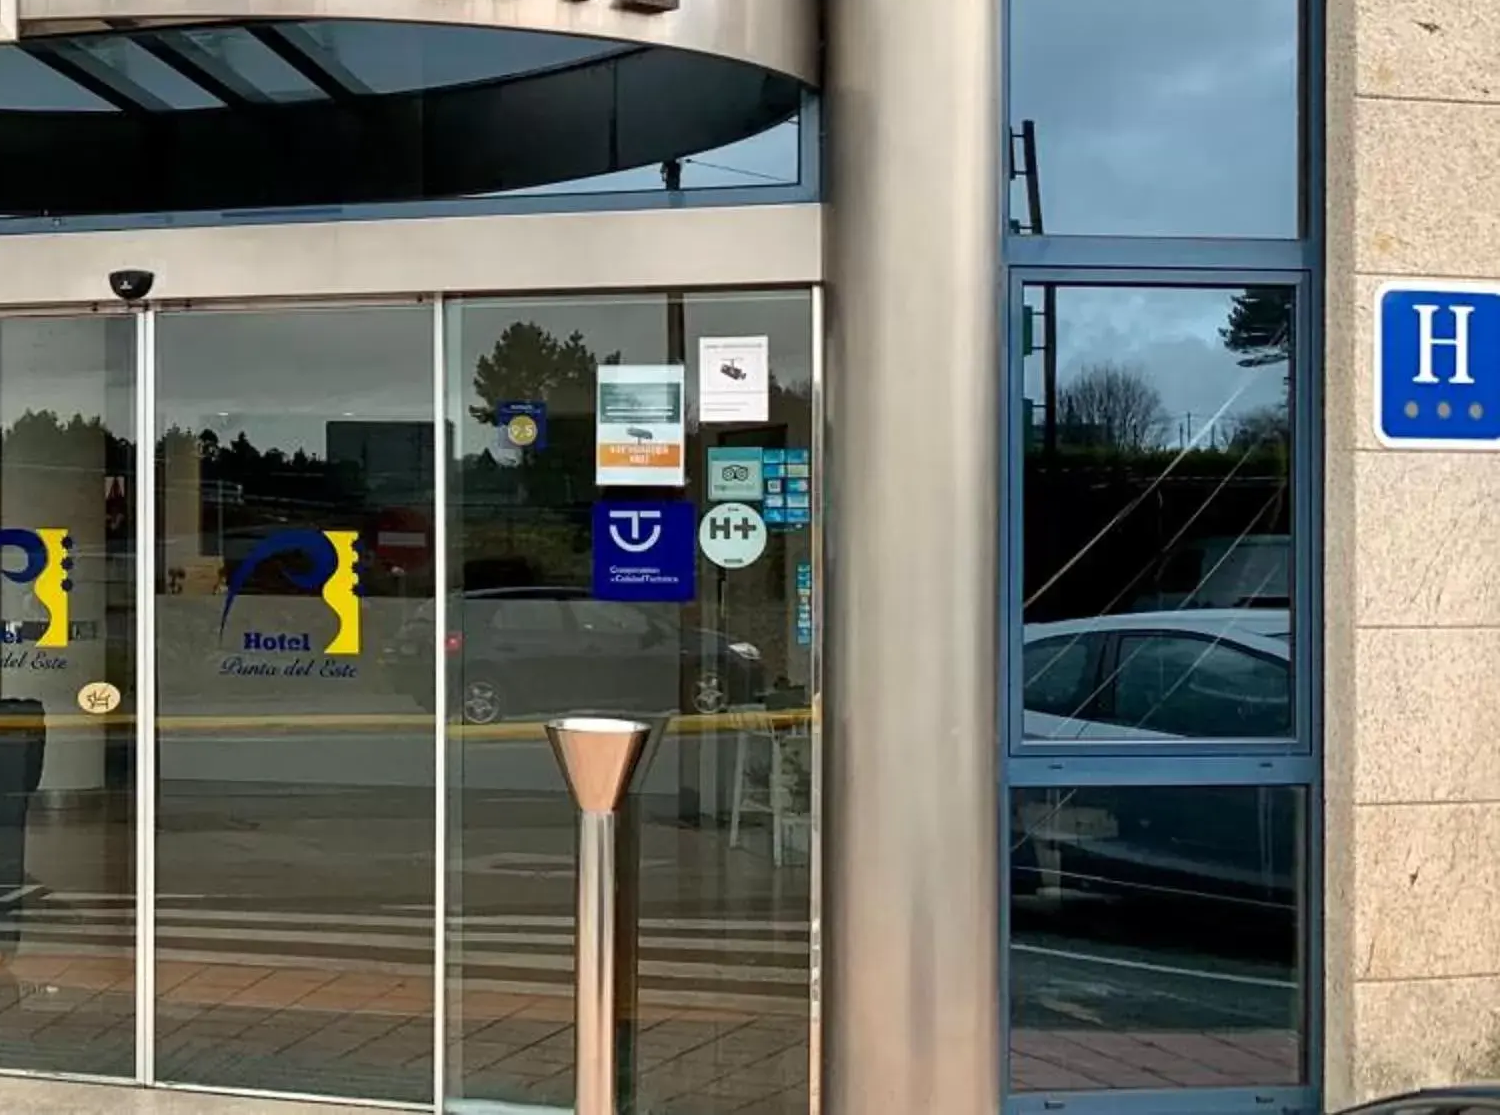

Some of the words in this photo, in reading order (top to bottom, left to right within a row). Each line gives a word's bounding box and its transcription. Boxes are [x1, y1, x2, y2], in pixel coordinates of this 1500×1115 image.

[1412, 303, 1476, 384] H
[243, 631, 311, 652] Hotel
[219, 654, 277, 676] Punta
[283, 657, 315, 677] del
[318, 658, 358, 678] Este
